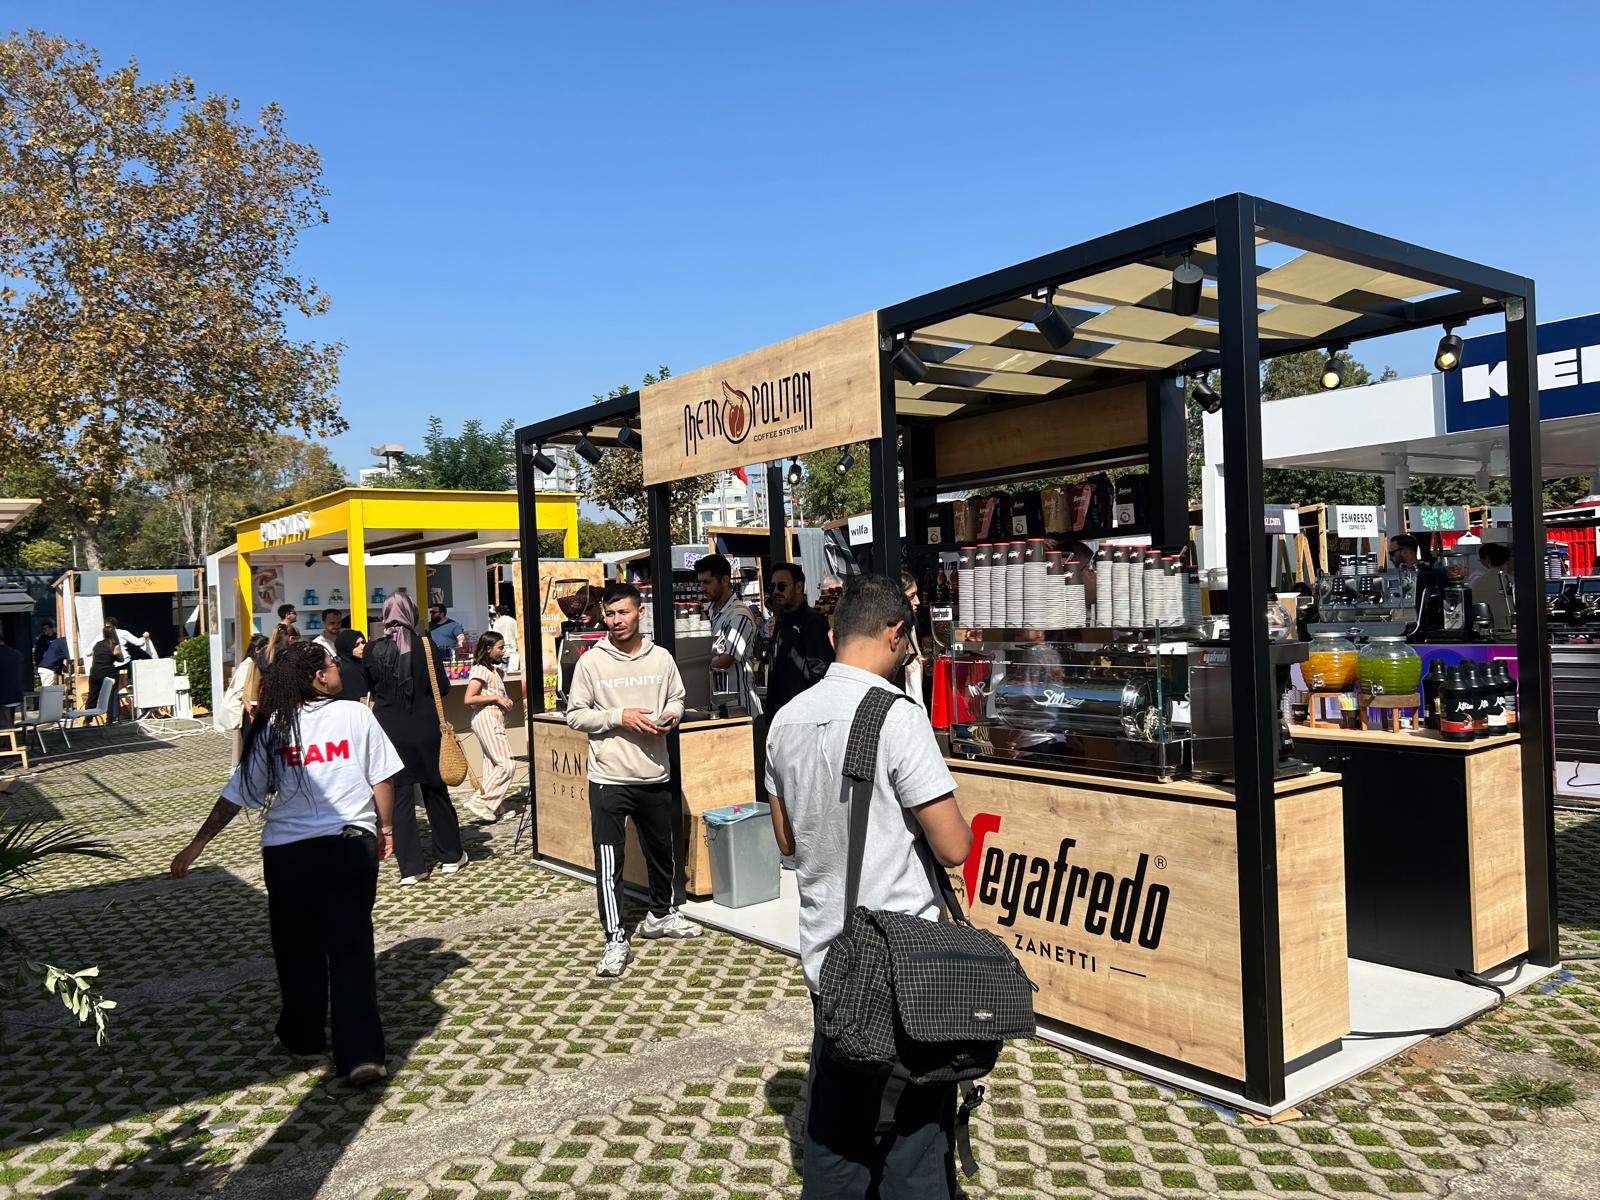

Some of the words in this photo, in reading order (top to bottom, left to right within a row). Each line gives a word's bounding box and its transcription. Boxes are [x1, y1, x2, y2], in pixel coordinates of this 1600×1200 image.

[684, 370, 813, 457] METROPOLITAN
[753, 430, 778, 442] COFFEE
[778, 424, 804, 437] SYSTEM
[1341, 513, 1373, 523] ESMRESSO
[596, 675, 664, 689] INFINITE
[274, 739, 349, 767] TEAM
[1014, 933, 1097, 973] ZANETTI
